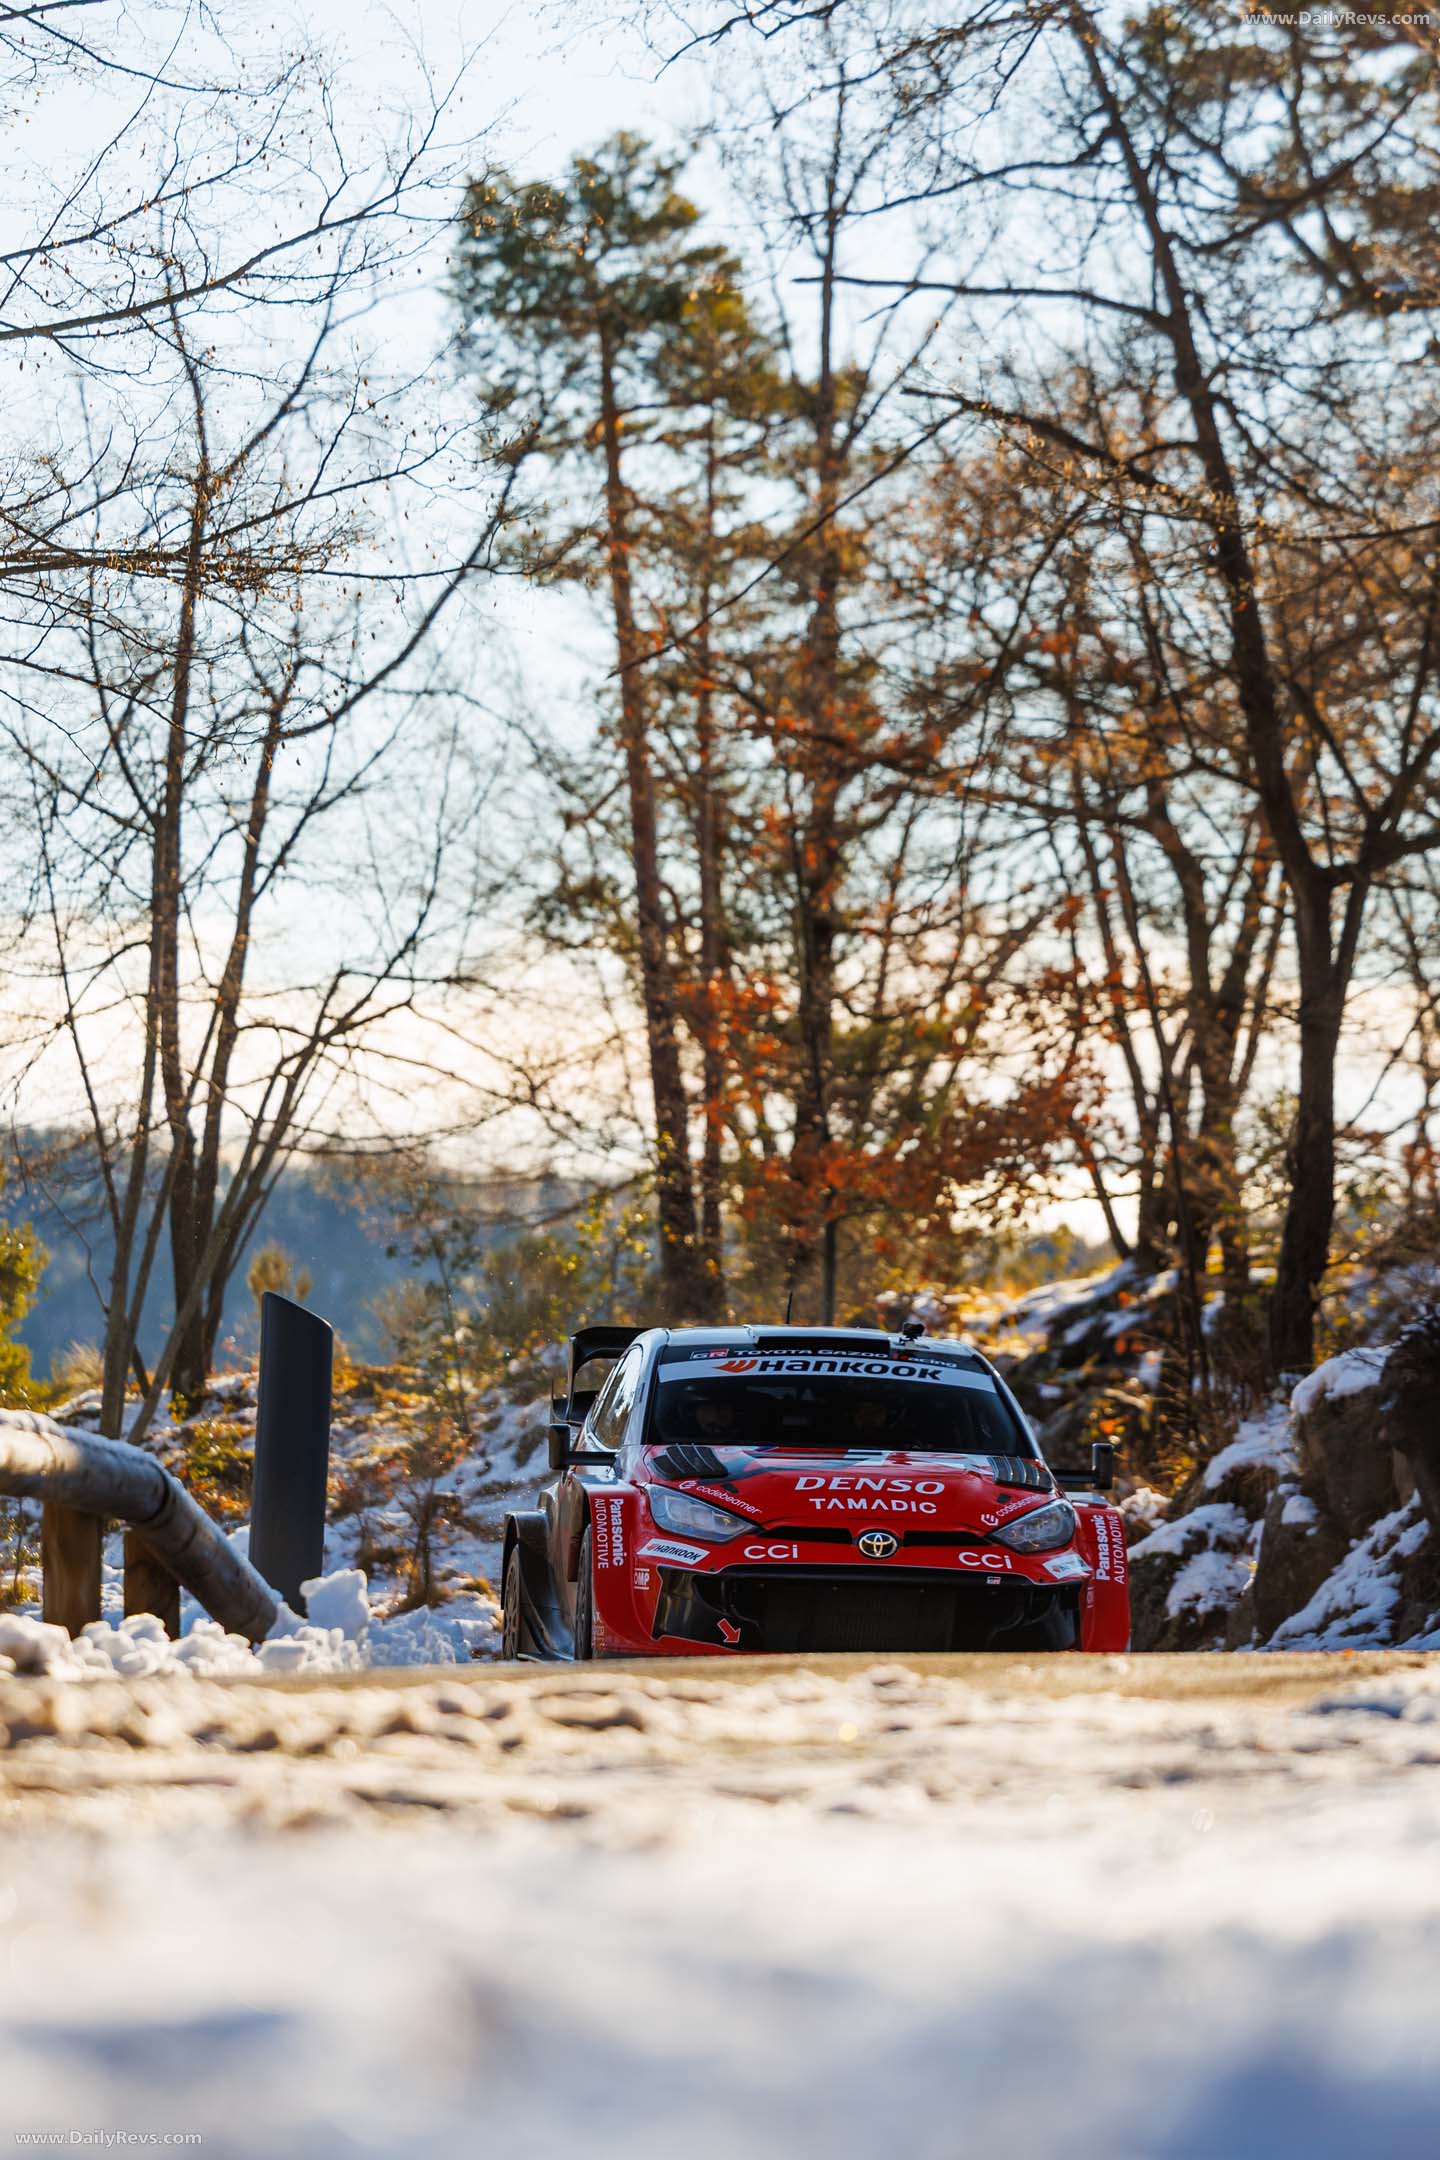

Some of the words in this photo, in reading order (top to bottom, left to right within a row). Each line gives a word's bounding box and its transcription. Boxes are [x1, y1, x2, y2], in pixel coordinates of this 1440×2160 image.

[691, 1349, 729, 1359] GR
[817, 1349, 888, 1358] GAZOO
[696, 1486, 761, 1514] codebeamer
[795, 1476, 945, 1495] DENSO
[809, 1498, 937, 1514] TAMADIC
[594, 1498, 609, 1569] AUTOMOTIVE
[609, 1498, 627, 1567] Panasonic
[1090, 1514, 1110, 1581] Panasonic
[1106, 1514, 1125, 1585] AUTOMOTIVE
